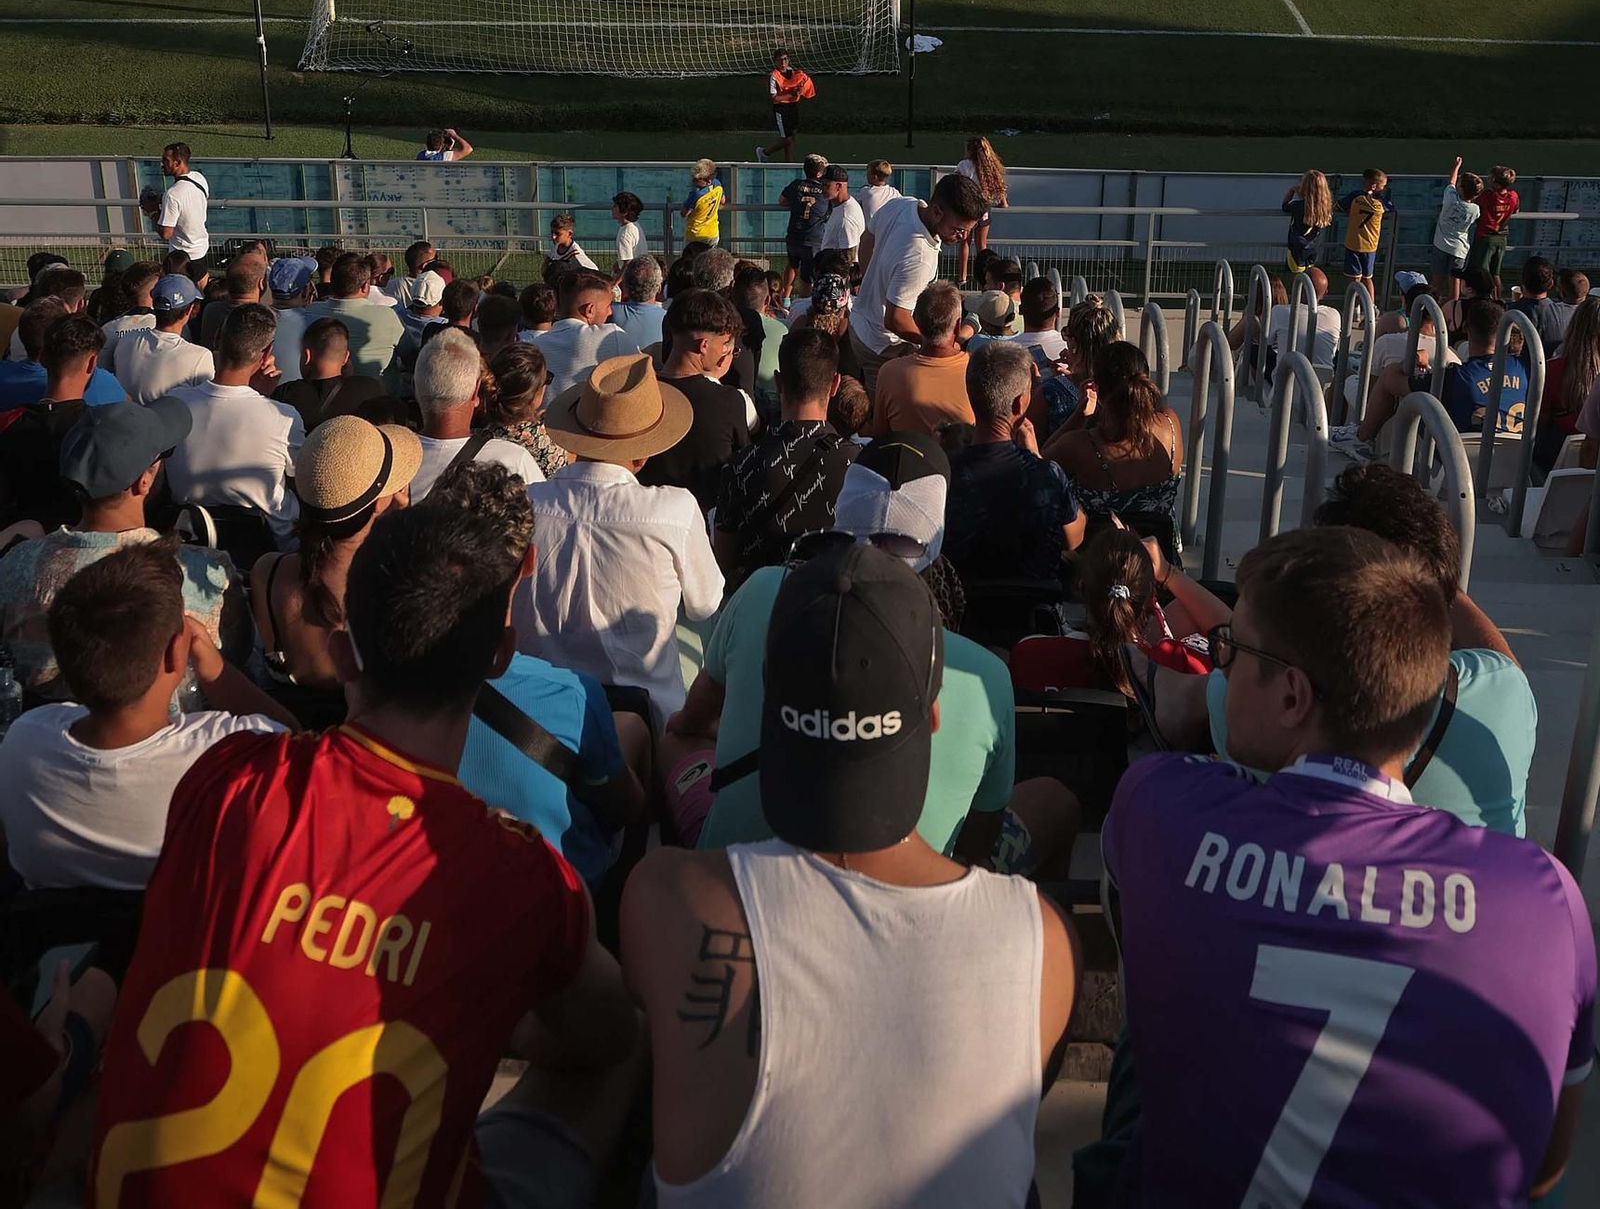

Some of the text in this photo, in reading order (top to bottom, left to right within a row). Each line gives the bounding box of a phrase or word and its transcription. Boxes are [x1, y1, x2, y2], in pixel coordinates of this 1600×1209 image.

[706, 200, 717, 220] 7
[801, 196, 817, 220] 7
[1359, 209, 1375, 229] 7
[1476, 374, 1520, 395] BAN
[781, 705, 902, 741] adidas
[1333, 756, 1368, 775] REAL
[1184, 831, 1478, 935] RONALDO
[261, 881, 432, 987] PEDRI
[97, 968, 450, 1209] 20
[1240, 943, 1417, 1209] 7
